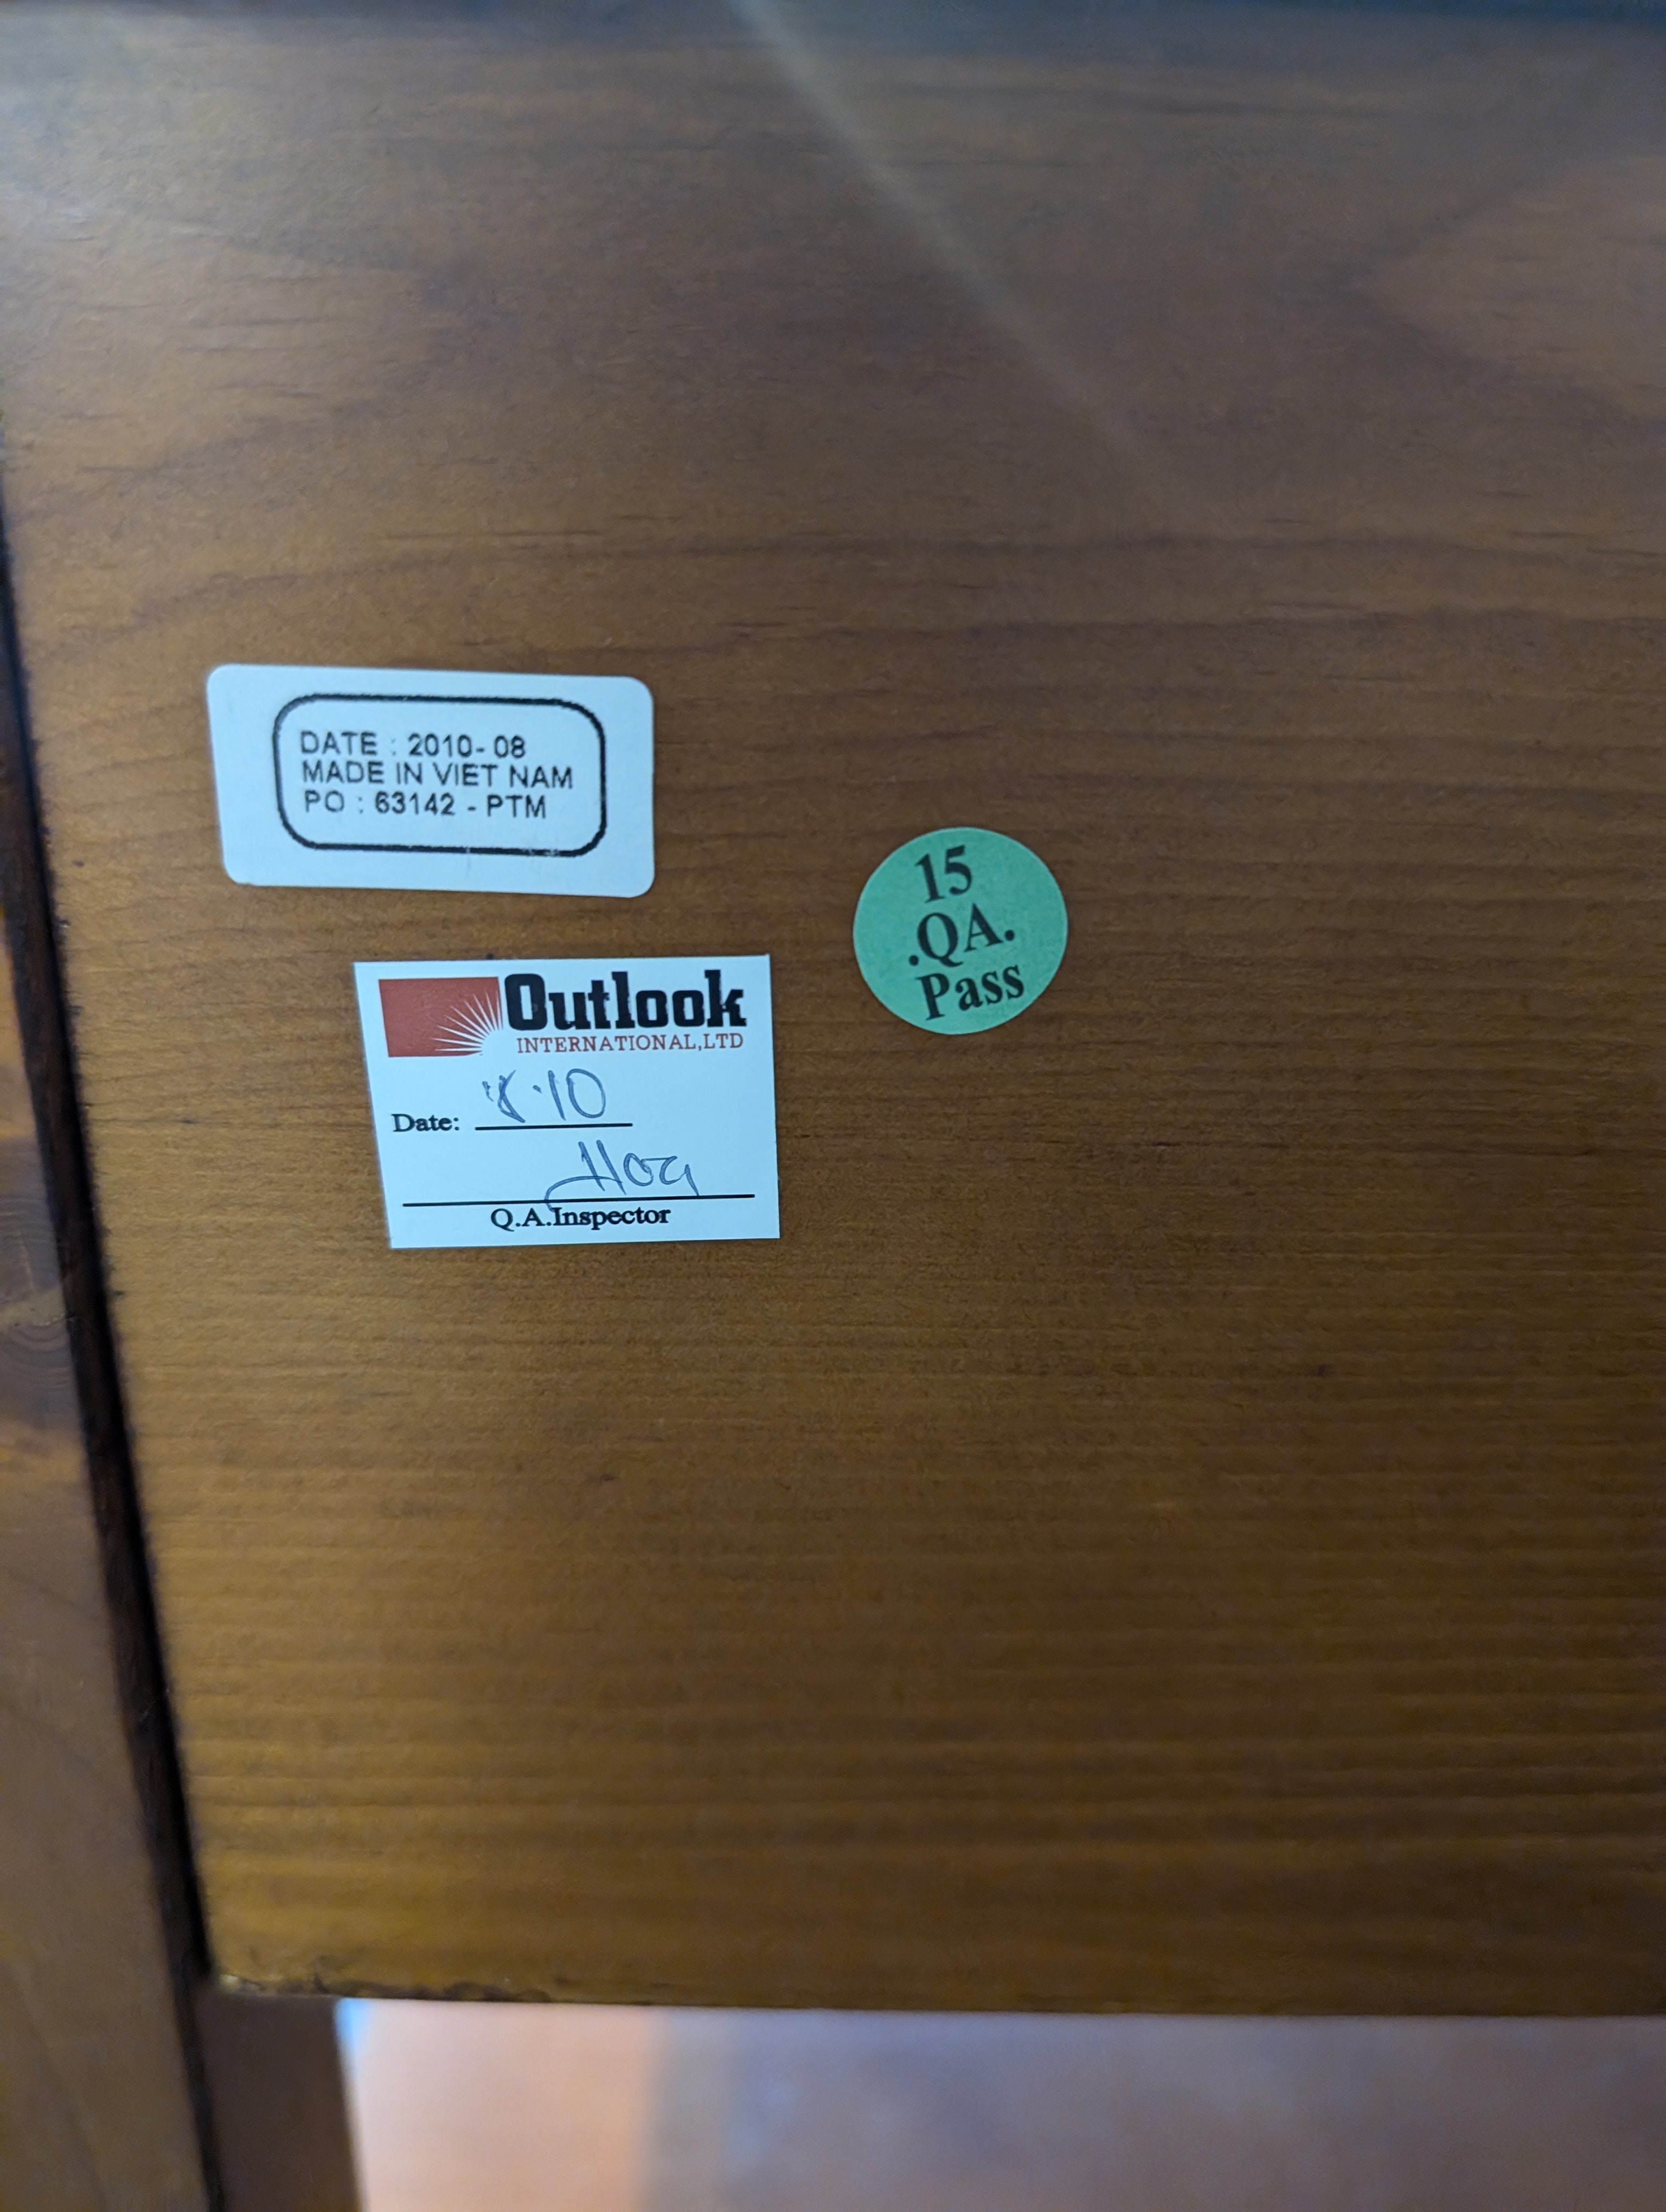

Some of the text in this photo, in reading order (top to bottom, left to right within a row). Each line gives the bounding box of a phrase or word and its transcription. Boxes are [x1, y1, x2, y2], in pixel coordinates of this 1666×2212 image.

[300, 731, 378, 756] DATE
[302, 762, 573, 789] MADE IN VIET NAM
[305, 791, 345, 813] PO
[375, 792, 456, 816] 63142
[487, 795, 546, 819] PTM
[914, 845, 972, 903] 15
[505, 969, 747, 1030] Outlook
[916, 965, 1024, 1020] Pass
[393, 1113, 460, 1133] Date:
